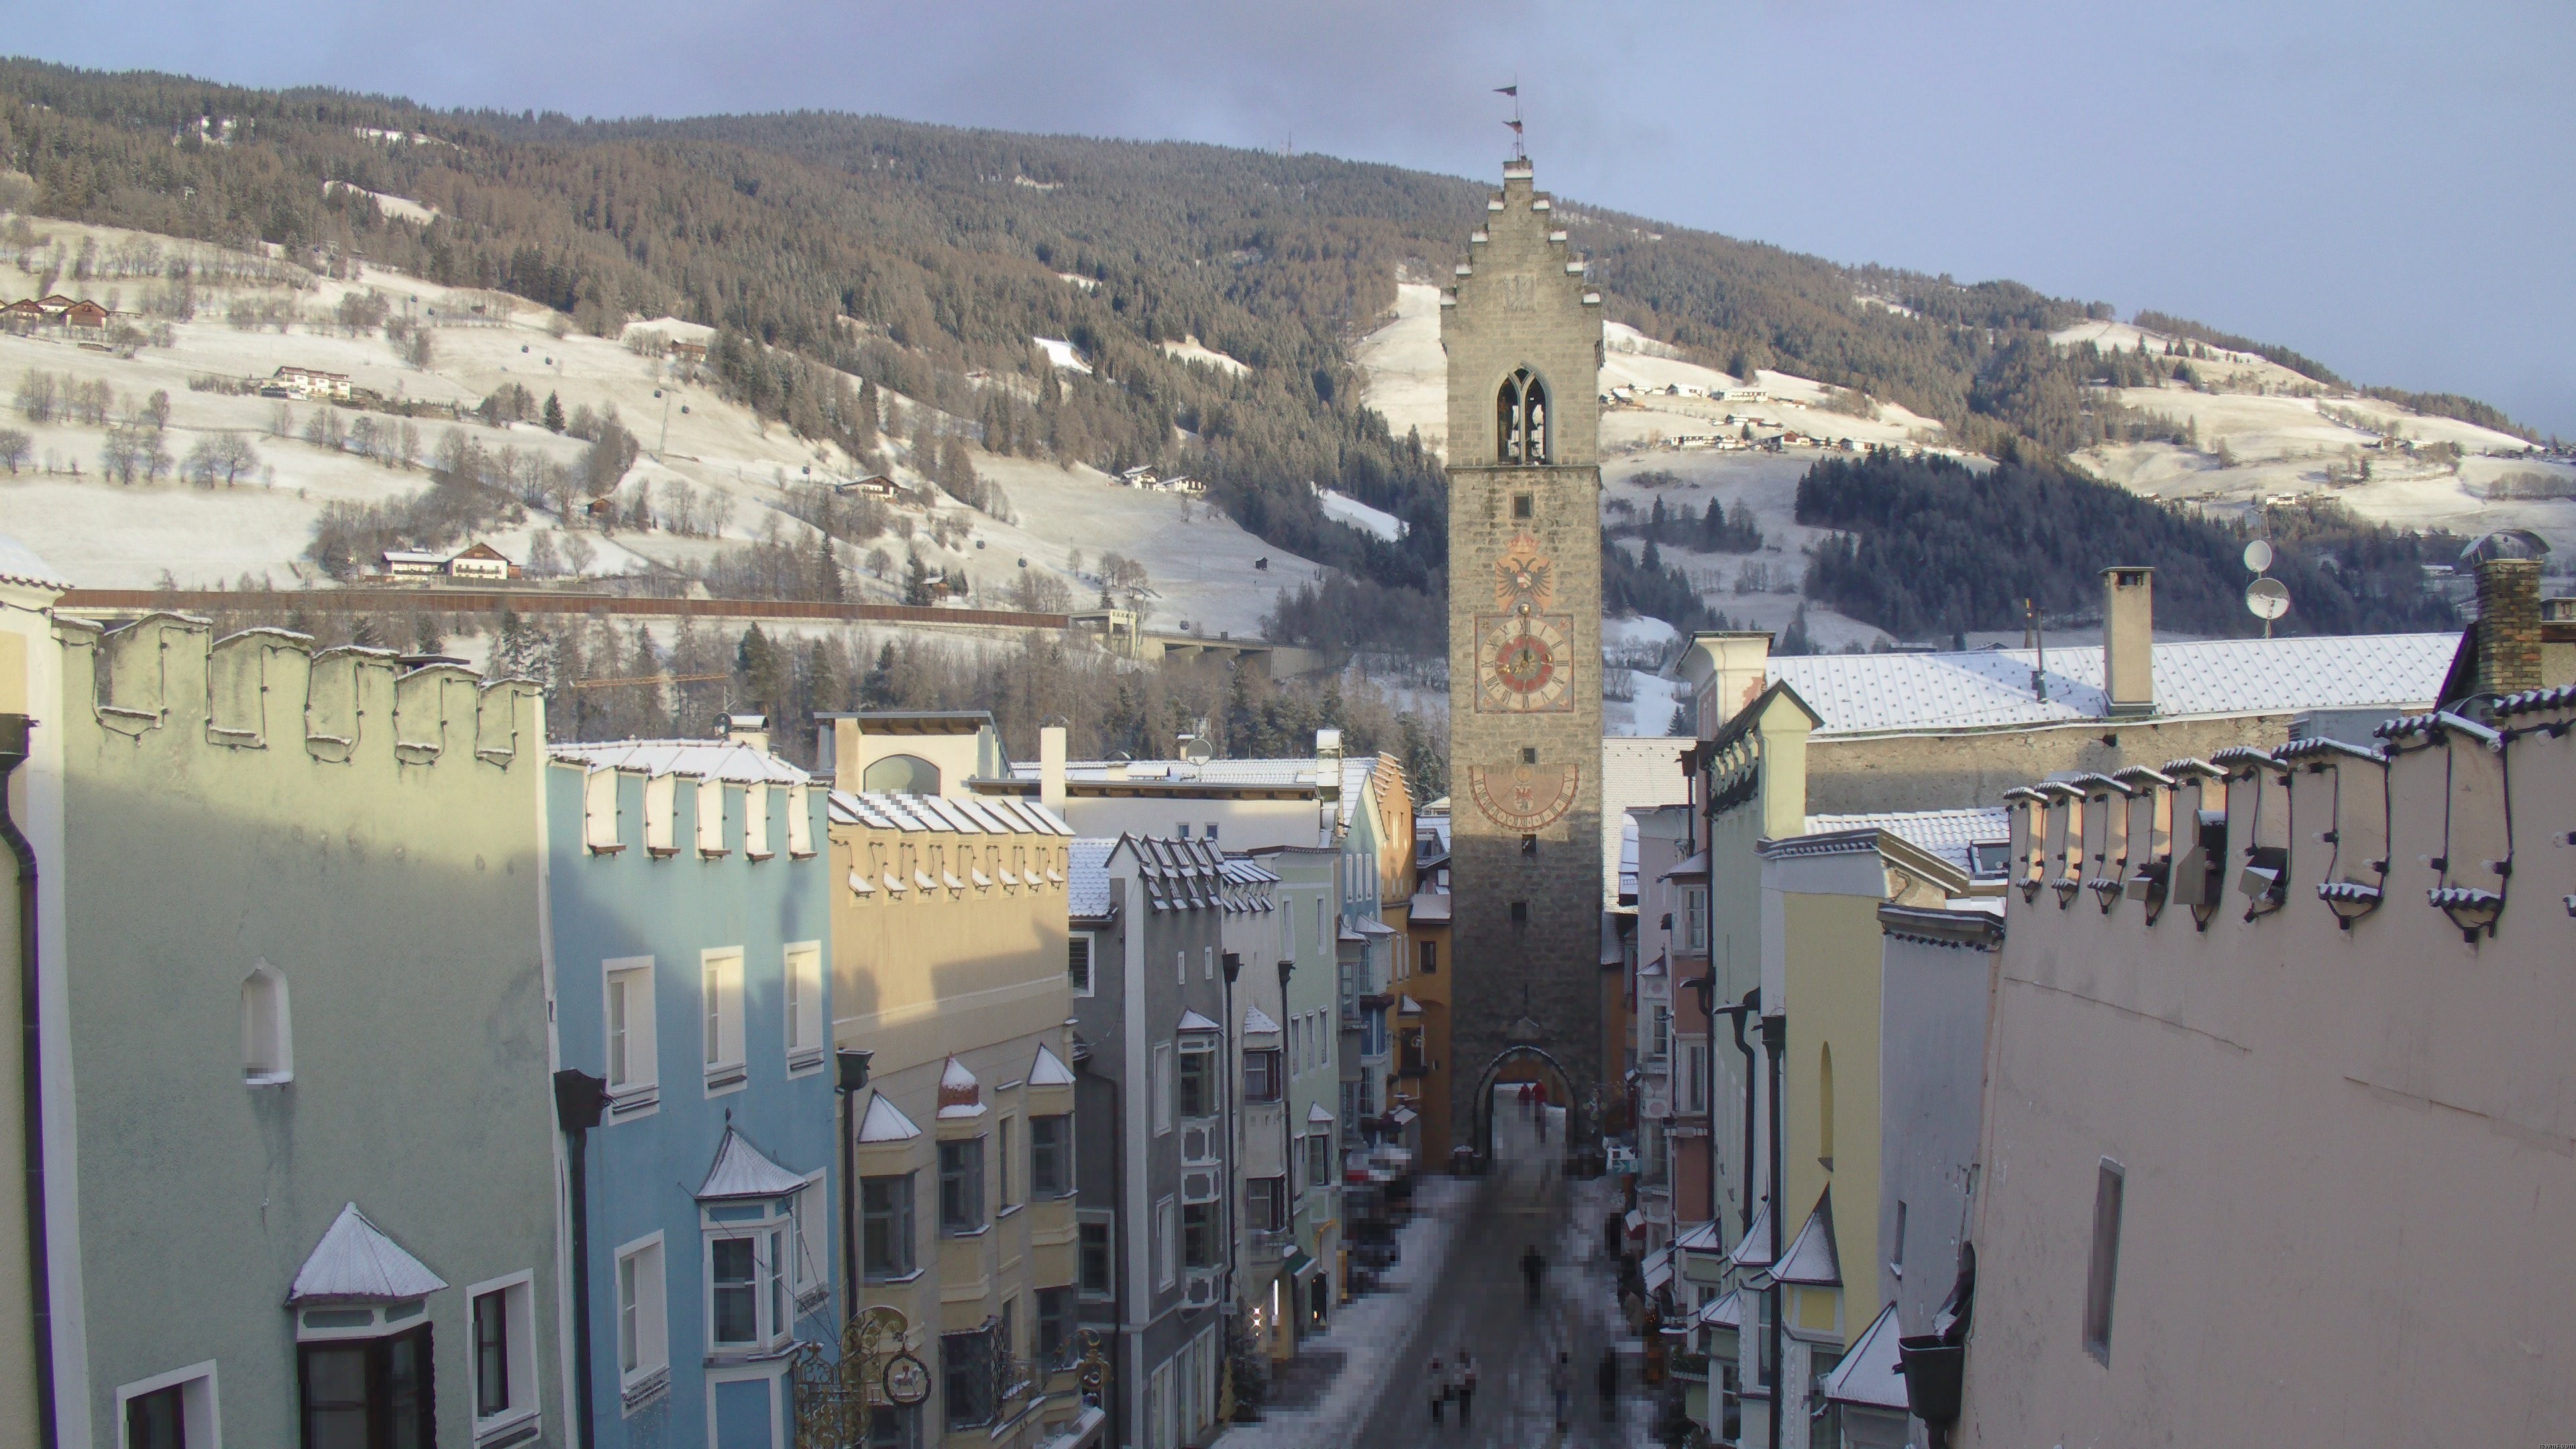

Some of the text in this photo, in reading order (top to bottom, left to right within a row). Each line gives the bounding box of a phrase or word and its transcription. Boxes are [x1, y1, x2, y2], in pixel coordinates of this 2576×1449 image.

[1540, 625, 1547, 637] I
[1550, 640, 1564, 649] II
[1481, 659, 1494, 668] IX
[1522, 694, 1530, 708] VI
[1540, 690, 1550, 703] V
